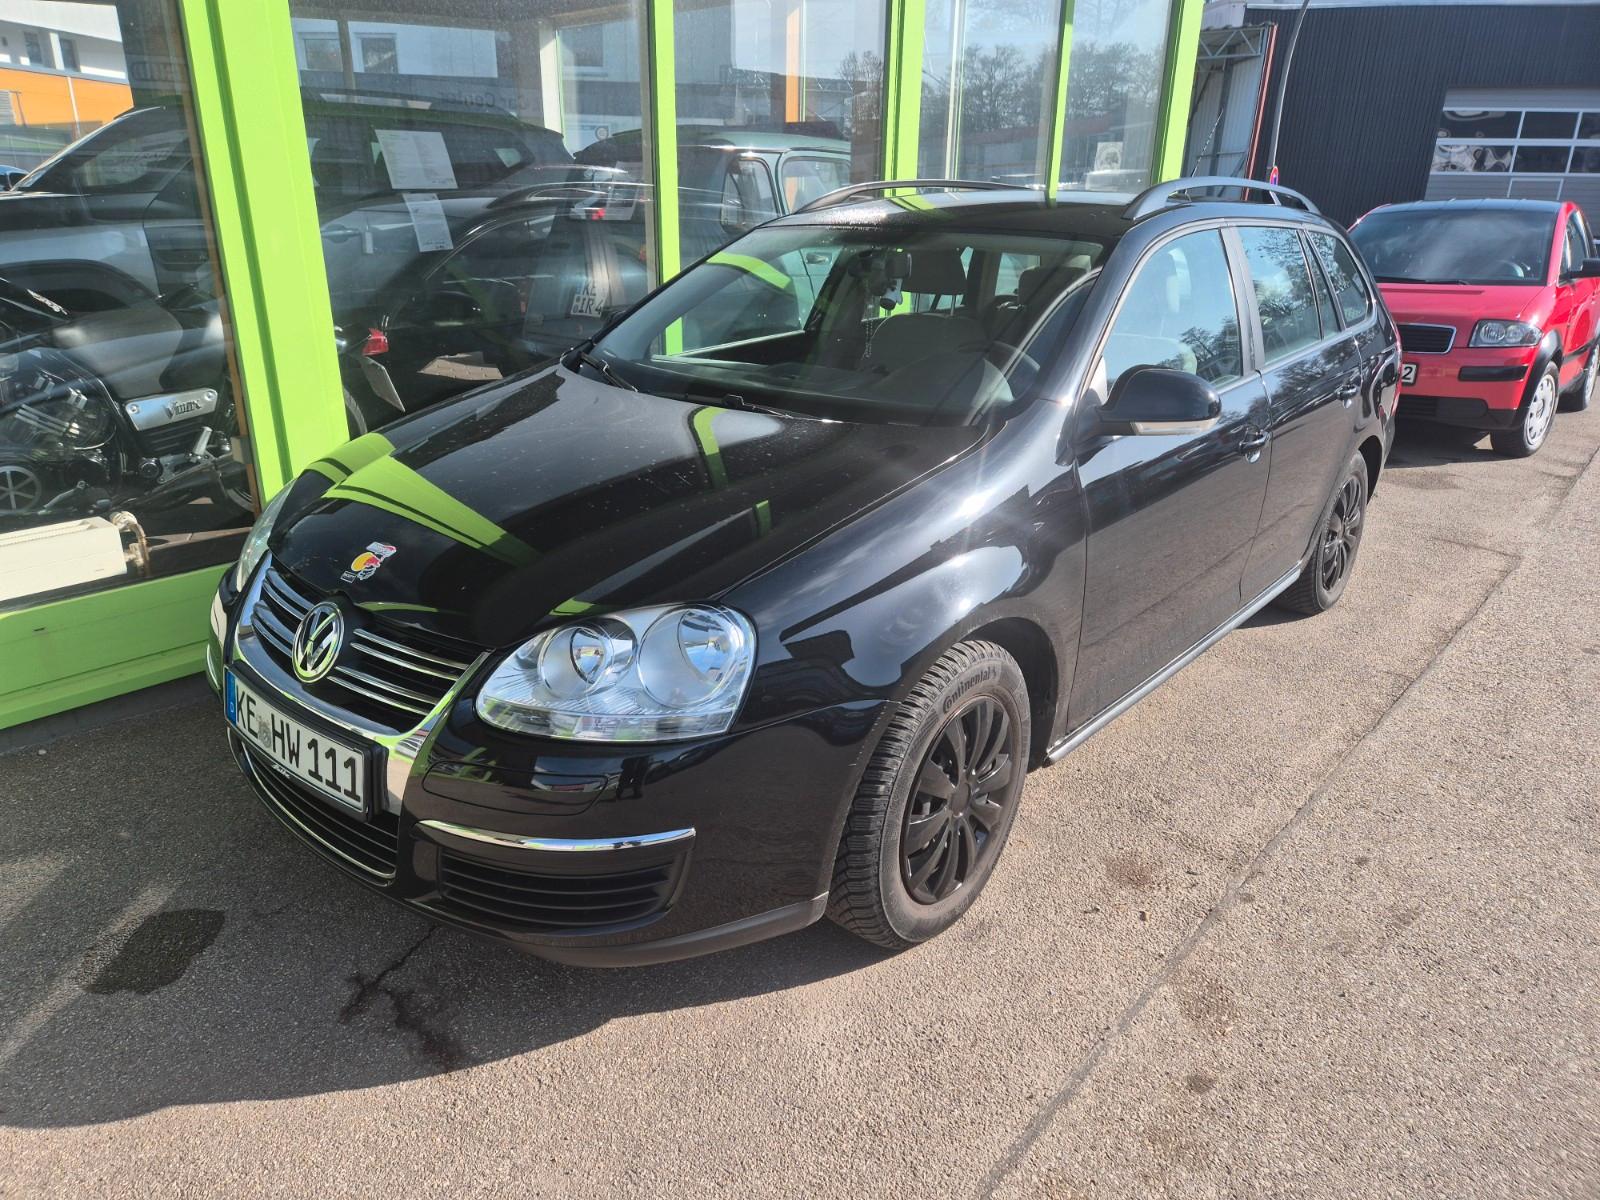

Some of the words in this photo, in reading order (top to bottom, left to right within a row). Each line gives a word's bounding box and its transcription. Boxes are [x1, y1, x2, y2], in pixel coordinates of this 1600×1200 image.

[1402, 366, 1413, 380] 2
[943, 666, 991, 714] Continental
[236, 686, 259, 738] KE
[271, 713, 301, 769] HW
[307, 738, 361, 803] 111
